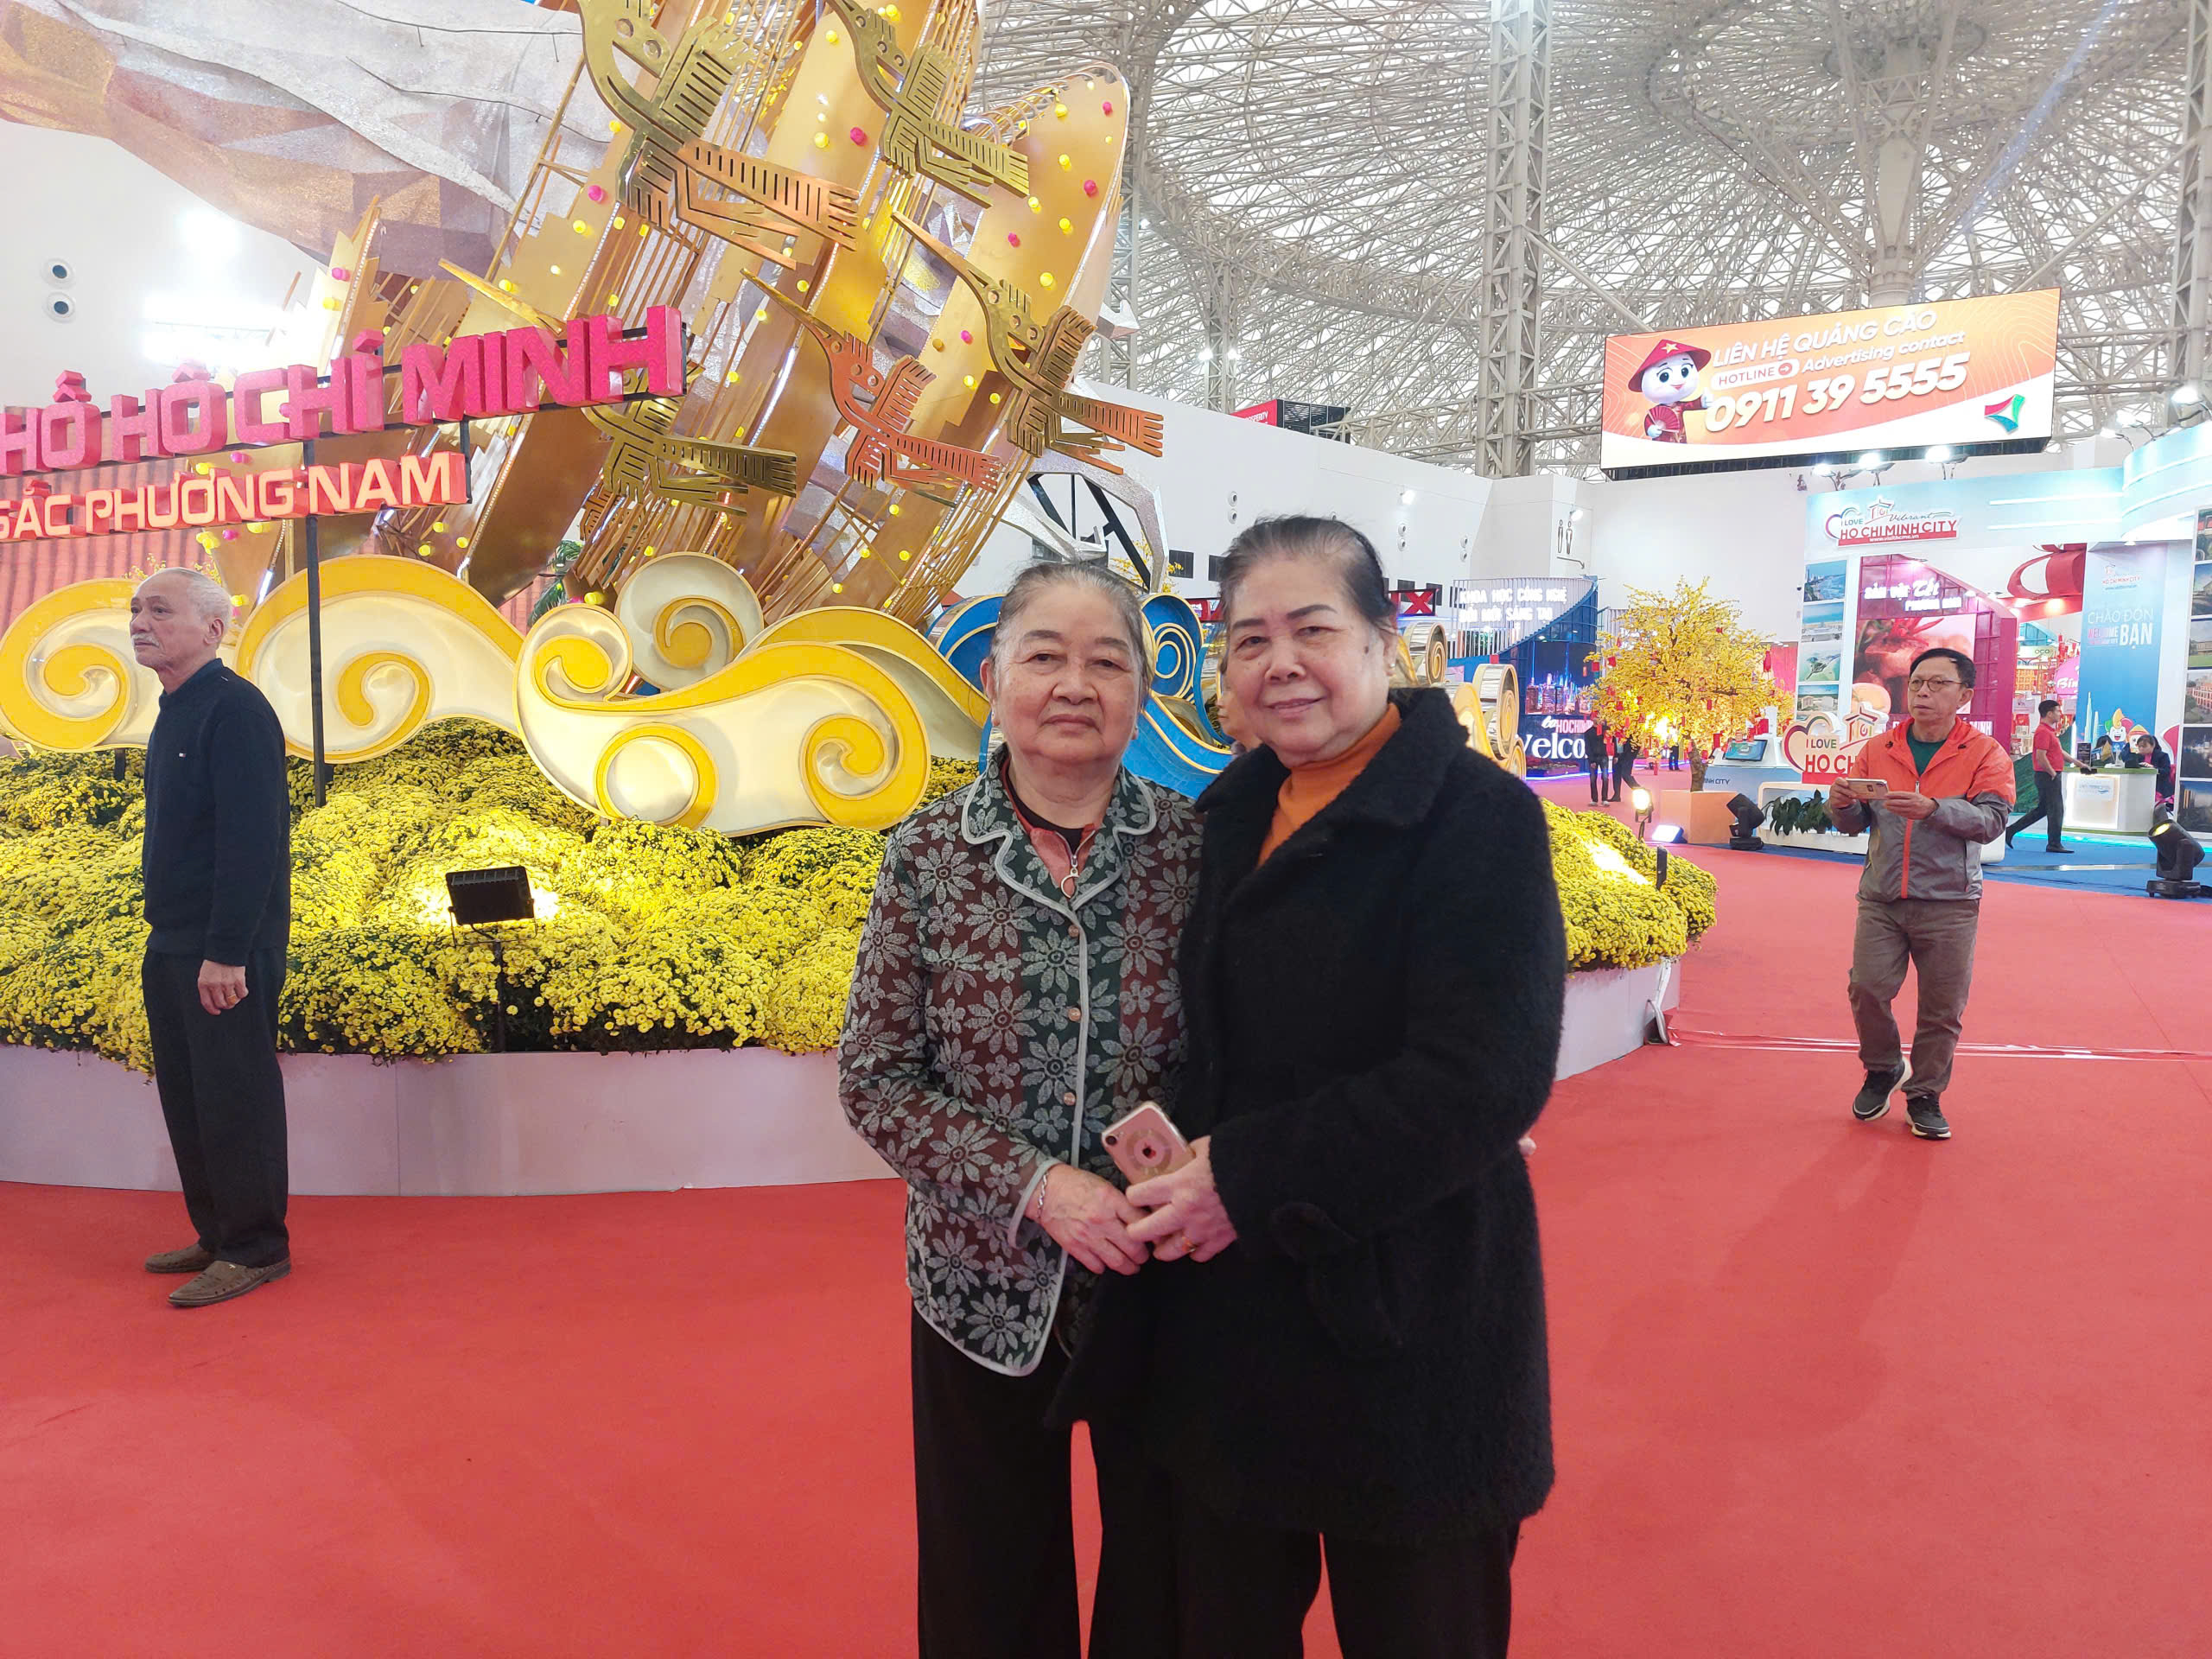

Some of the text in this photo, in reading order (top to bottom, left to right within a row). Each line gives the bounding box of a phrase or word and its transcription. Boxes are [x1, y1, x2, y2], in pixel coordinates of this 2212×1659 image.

[1713, 341, 1757, 367] LIÊN
[1761, 334, 1791, 361] HỆ
[1802, 330, 1966, 373] Advertising contact
[233, 329, 385, 445] CHÍ
[402, 305, 683, 425] MINH
[1719, 366, 1775, 385] HOTLINE
[1705, 352, 1971, 432] 0911 39 5555
[308, 451, 467, 515] NAM
[1840, 519, 1957, 541] HO CHI MINH CITY
[2120, 622, 2153, 650] BẠN
[1523, 733, 1588, 759] elco
[1810, 739, 1837, 748] LOVE
[1806, 754, 1858, 775] HO CH
